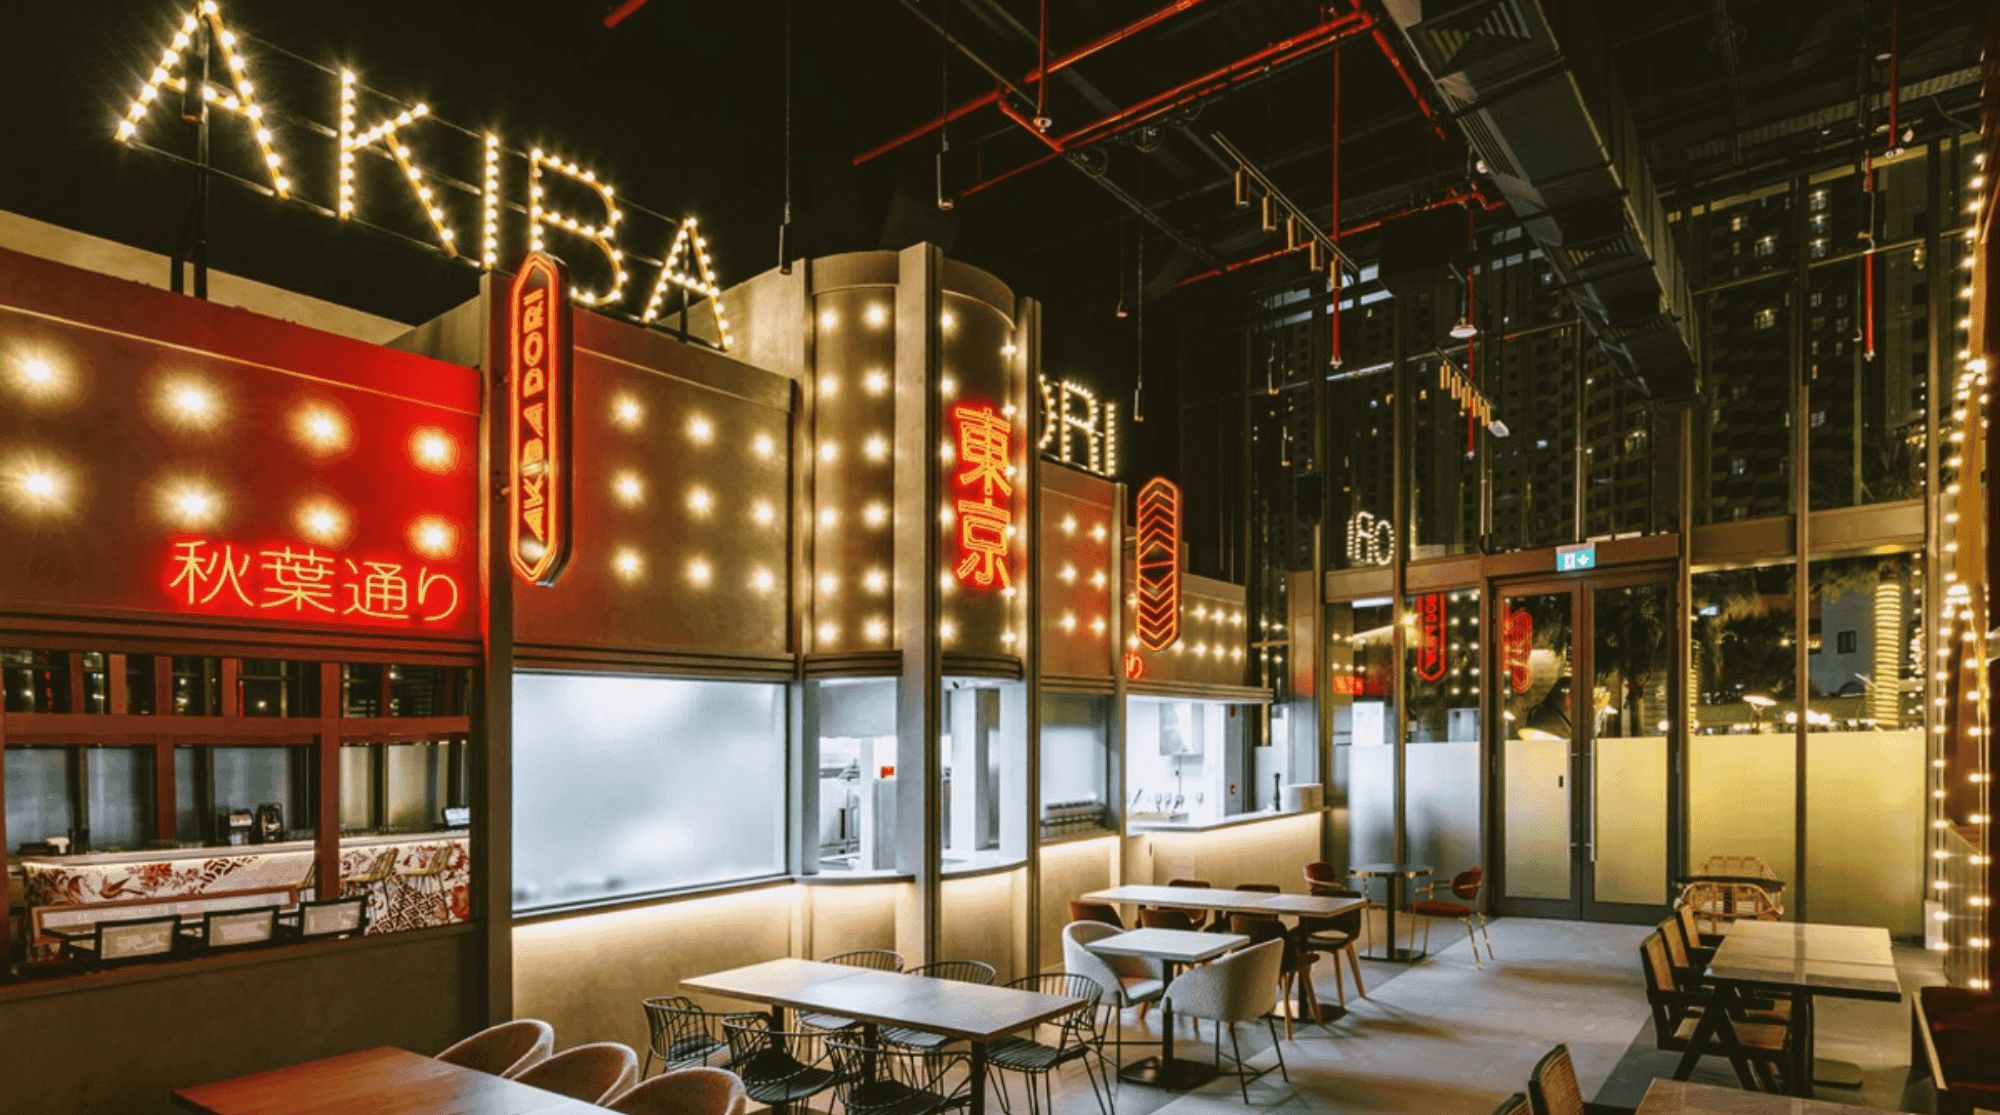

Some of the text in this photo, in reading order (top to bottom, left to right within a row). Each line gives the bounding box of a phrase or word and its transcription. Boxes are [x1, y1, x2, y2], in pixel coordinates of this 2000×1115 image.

[114, 0, 731, 353] AKIBA
[522, 287, 546, 541] AKIBA DORI
[956, 407, 1013, 588] 東京
[169, 539, 459, 622] 秋葉通り
